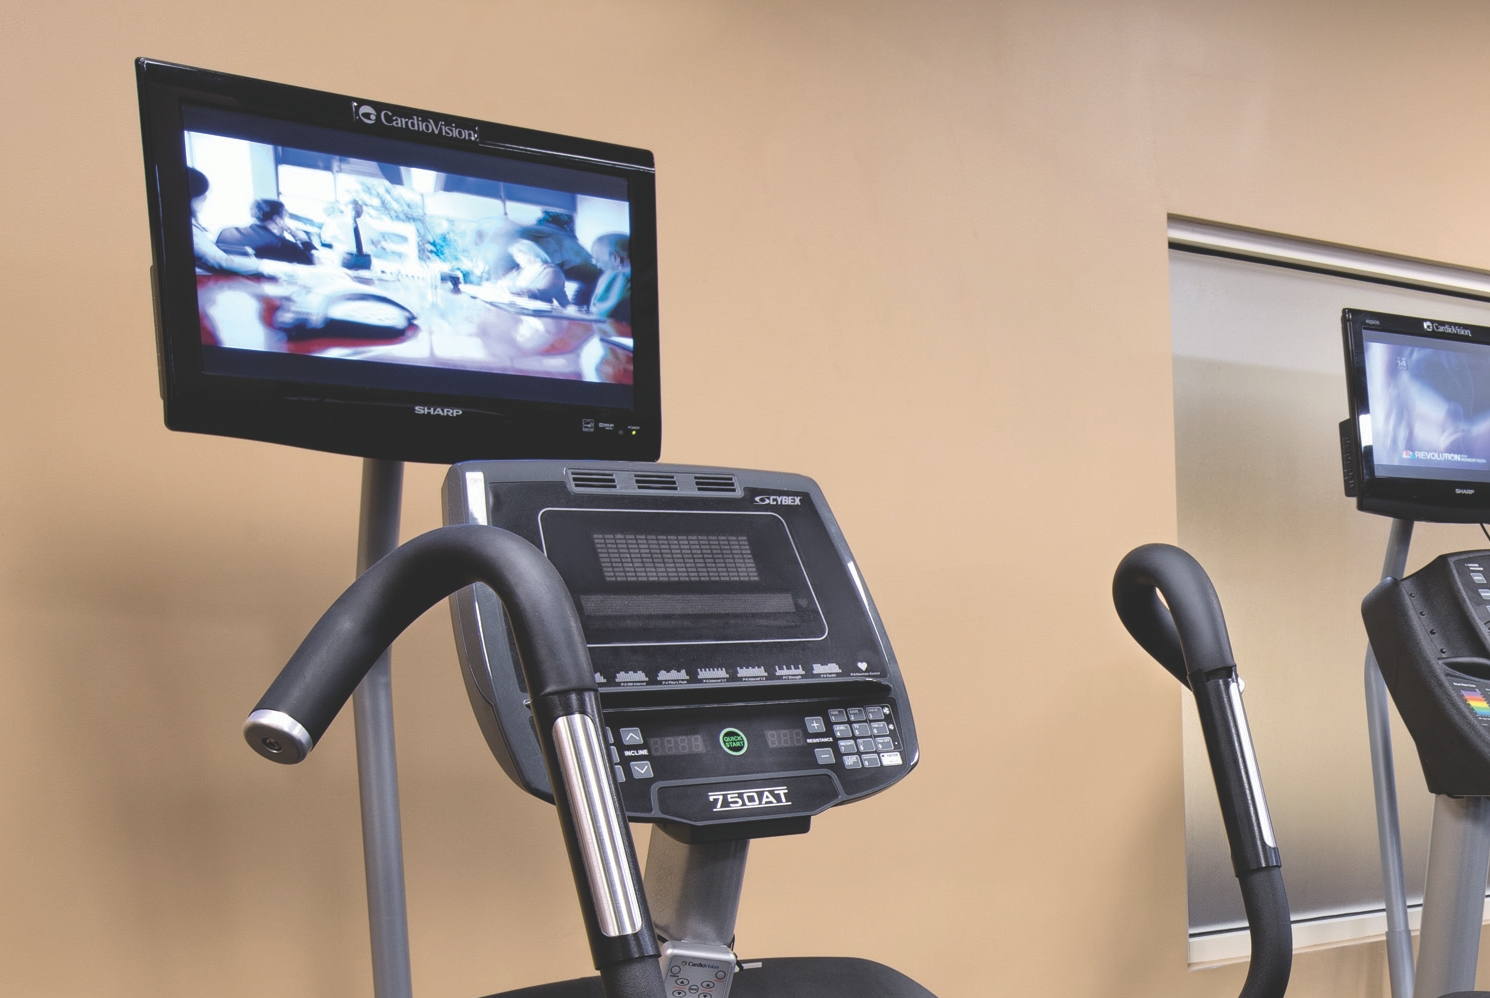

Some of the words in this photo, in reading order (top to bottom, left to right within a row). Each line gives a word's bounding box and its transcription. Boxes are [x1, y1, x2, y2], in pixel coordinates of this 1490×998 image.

[381, 110, 475, 140] CardioVision
[1433, 323, 1472, 337] CardioVision
[414, 405, 463, 417] SHARP
[1415, 451, 1461, 463] REVOLUTION
[770, 495, 801, 505] CYBEX
[624, 749, 649, 757] INCLINE
[709, 789, 789, 809] 750AT
